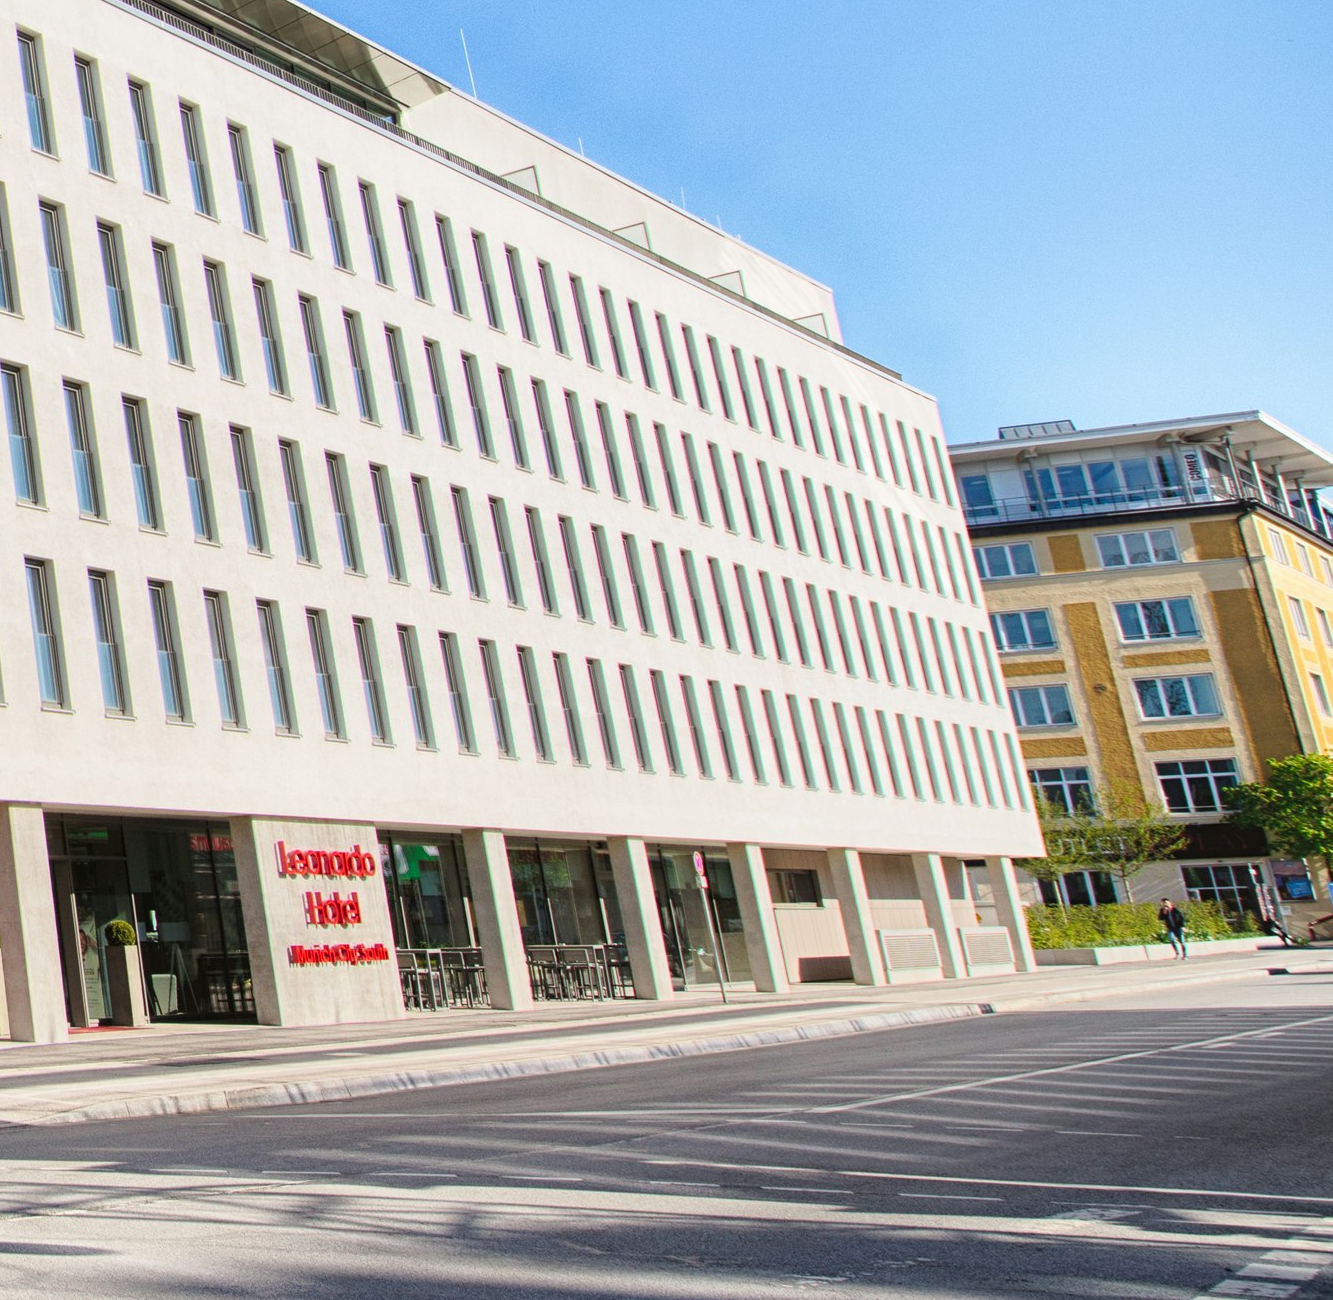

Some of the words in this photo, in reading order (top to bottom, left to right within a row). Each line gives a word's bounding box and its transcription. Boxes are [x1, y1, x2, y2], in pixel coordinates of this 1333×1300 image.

[277, 840, 376, 877] Leonardo
[305, 891, 362, 925] Hotel
[290, 945, 334, 964] Munich
[334, 944, 357, 966] City
[356, 943, 389, 961] South
